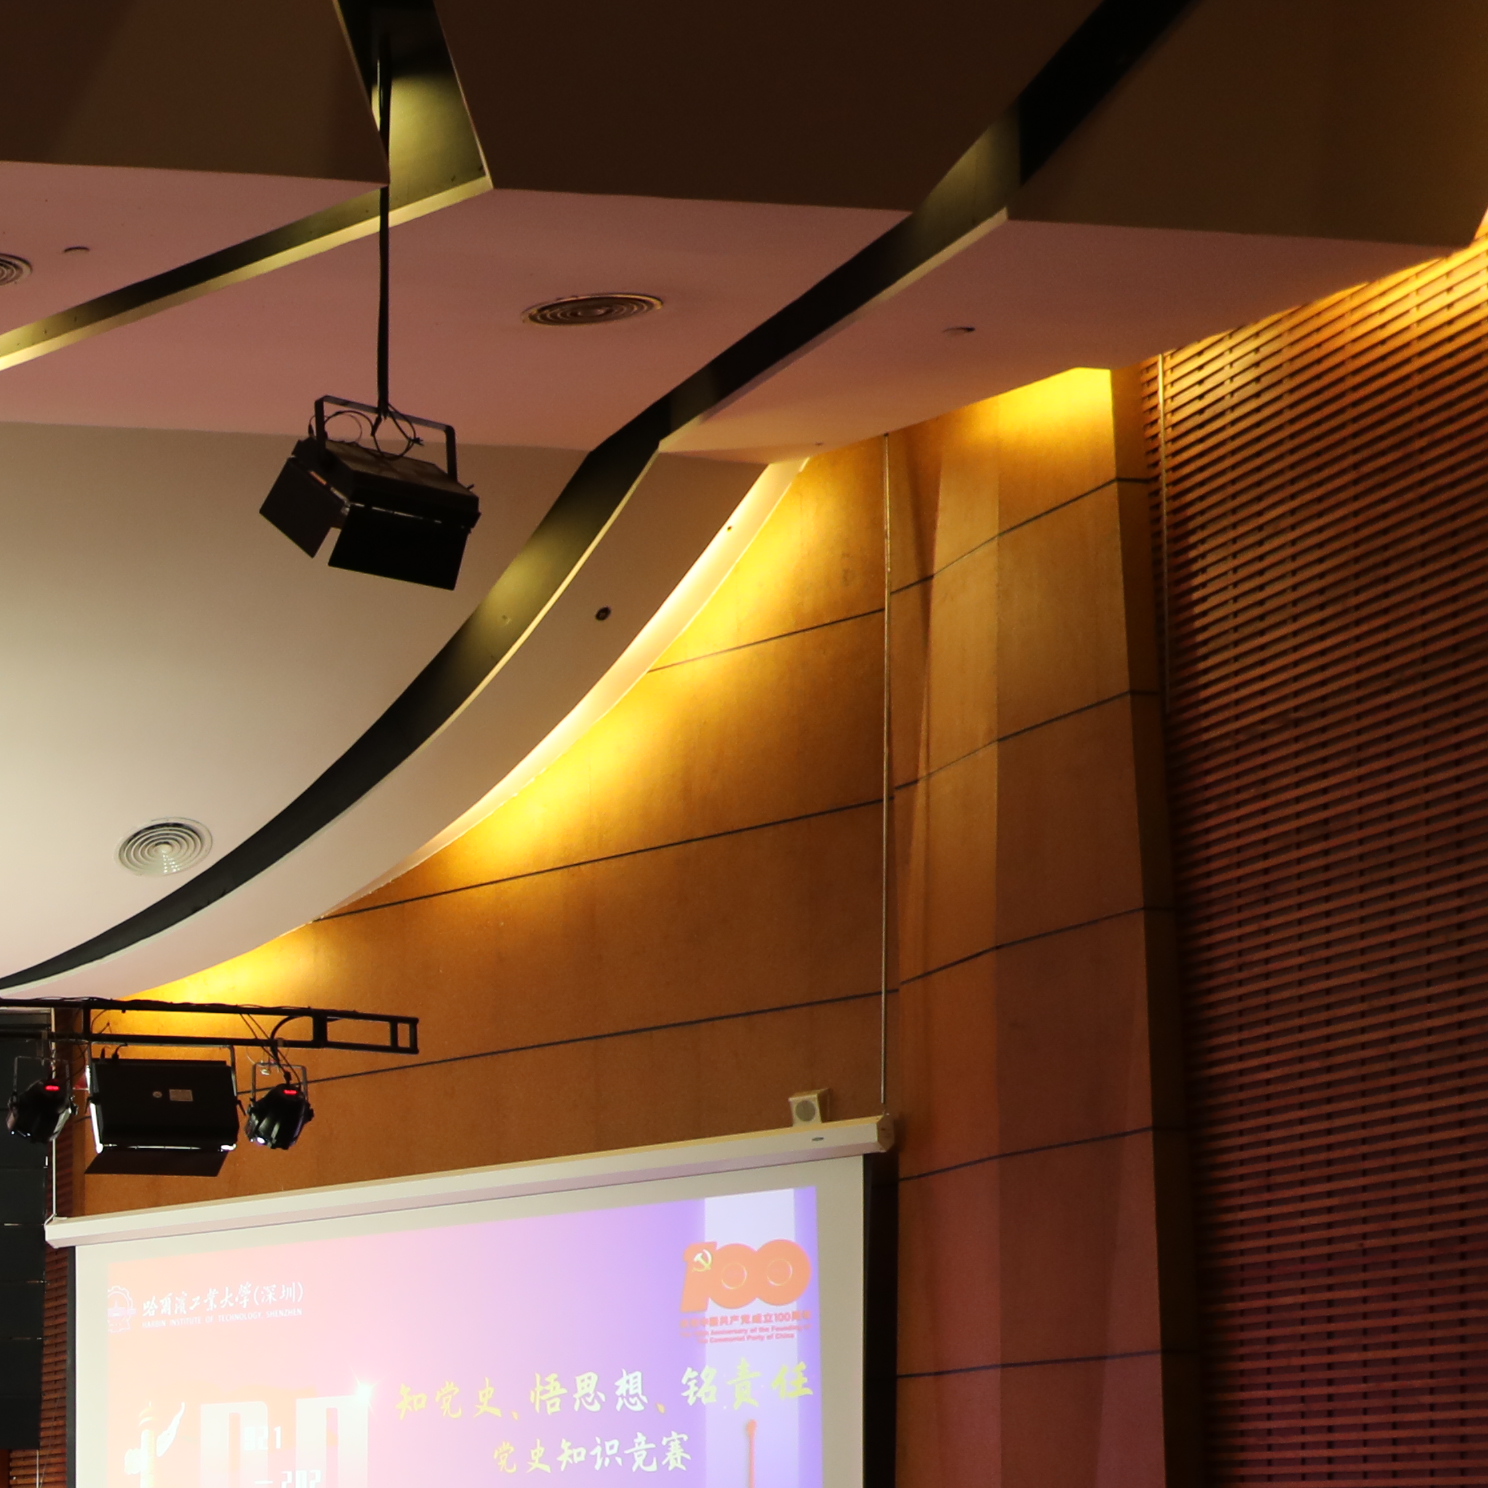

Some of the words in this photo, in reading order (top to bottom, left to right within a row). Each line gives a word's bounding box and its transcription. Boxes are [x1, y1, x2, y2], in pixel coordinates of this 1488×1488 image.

[493, 1430, 692, 1474] 党史知识竞赛
